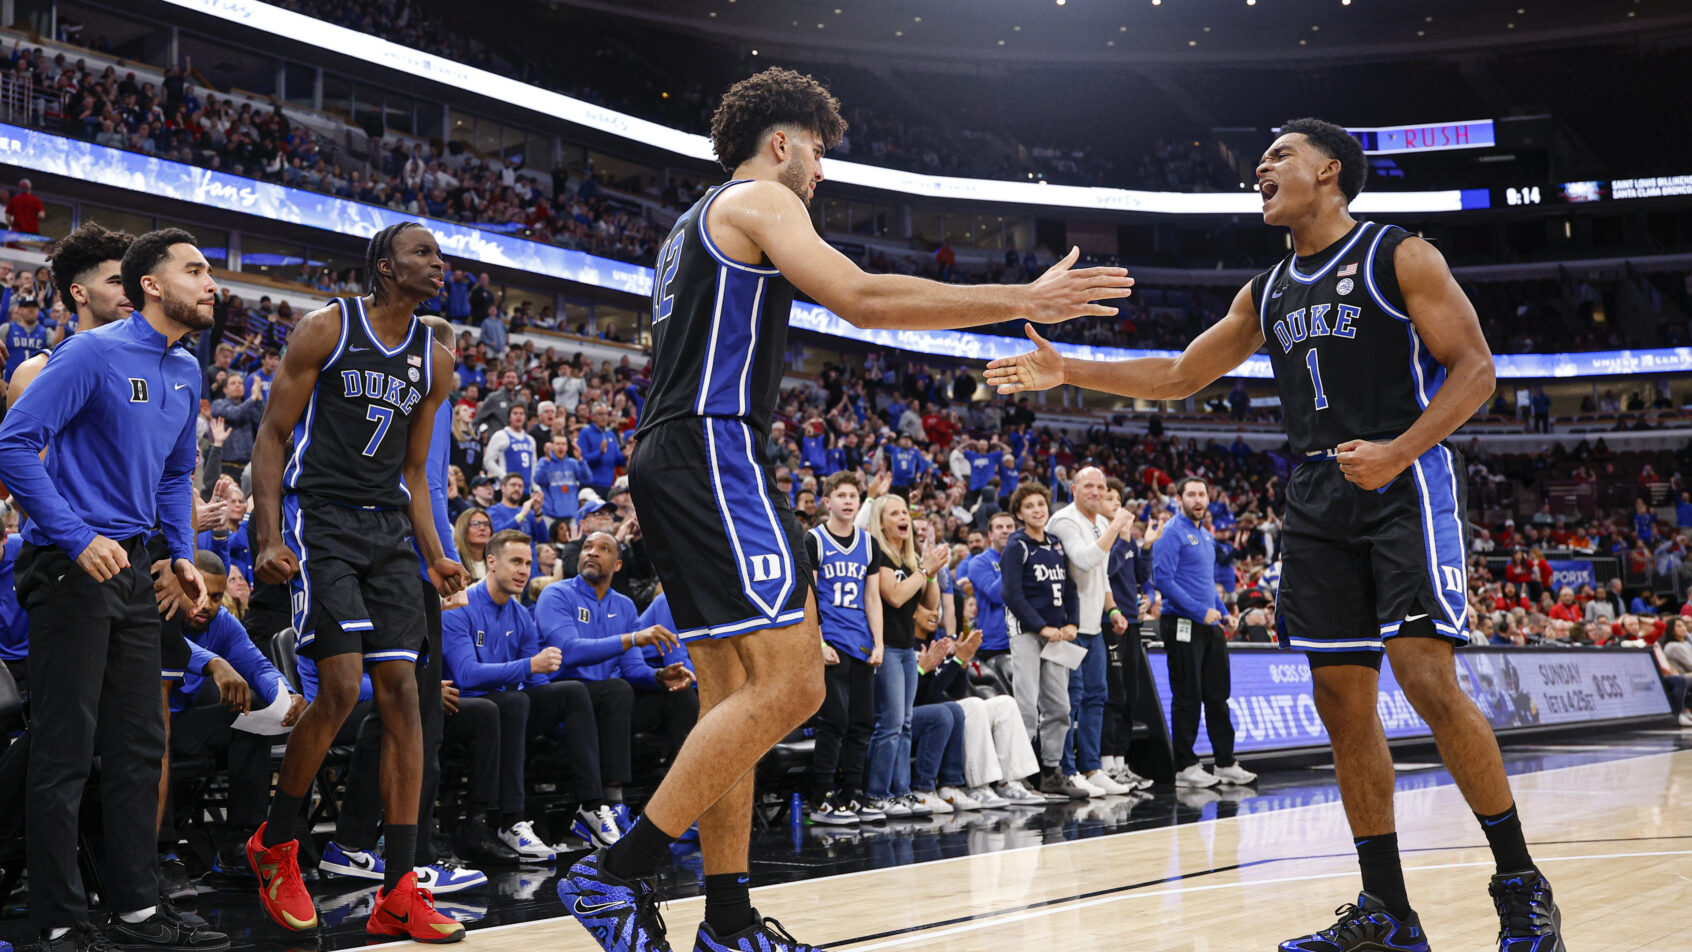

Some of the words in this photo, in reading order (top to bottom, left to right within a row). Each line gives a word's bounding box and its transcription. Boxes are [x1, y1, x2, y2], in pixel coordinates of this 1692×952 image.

[1405, 125, 1470, 148] RUSH
[1612, 180, 1633, 190] SAINT
[1635, 178, 1656, 188] LOUIS
[1613, 189, 1637, 199] SANTA
[1637, 187, 1661, 197] CLARA
[652, 229, 685, 327] 12
[1273, 303, 1361, 354] DUKE
[13, 337, 42, 349] DUKE
[1306, 348, 1329, 411] 1
[341, 370, 421, 416] DUKE
[362, 404, 394, 457] 7
[749, 554, 781, 582] D
[823, 561, 867, 580] DUKE
[1033, 563, 1066, 582] Duk
[1441, 566, 1463, 593] D
[1552, 571, 1588, 584] PORTS
[832, 581, 858, 608] 12
[1052, 583, 1063, 607] 5
[1279, 664, 1299, 682] CBS
[1539, 663, 1581, 686] SUNDAY
[1600, 674, 1623, 698] CBS
[1226, 695, 1298, 742] OUNT
